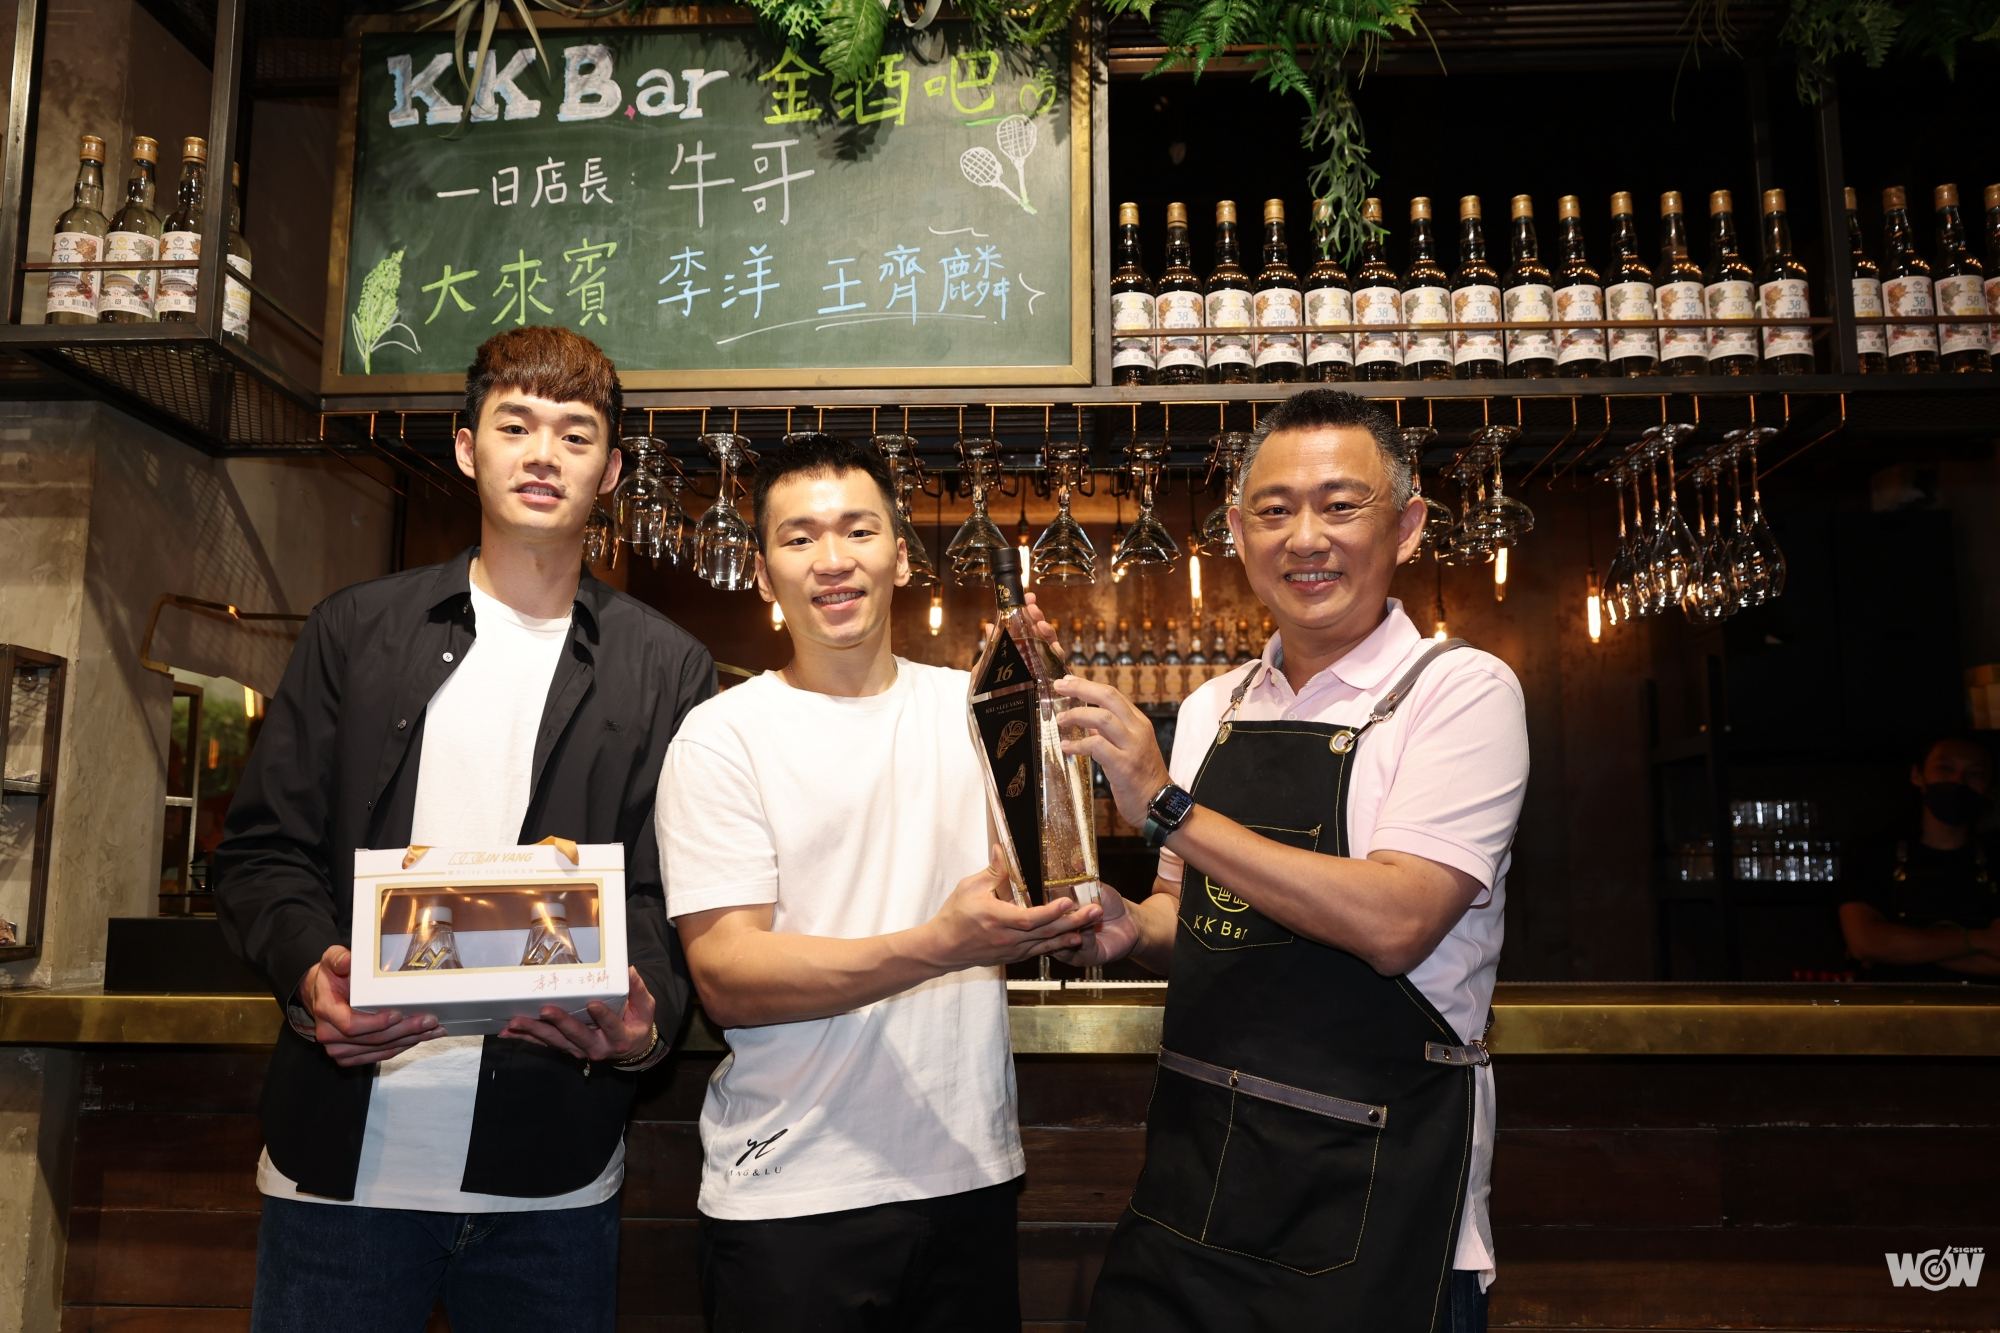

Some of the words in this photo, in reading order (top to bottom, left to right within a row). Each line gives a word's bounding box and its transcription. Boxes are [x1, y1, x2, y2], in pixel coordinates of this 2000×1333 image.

[758, 46, 999, 125] 金酒吧
[668, 139, 815, 228] 牛哥
[421, 237, 618, 326] 大來賓
[658, 243, 780, 319] 李洋
[994, 662, 1015, 684] 16
